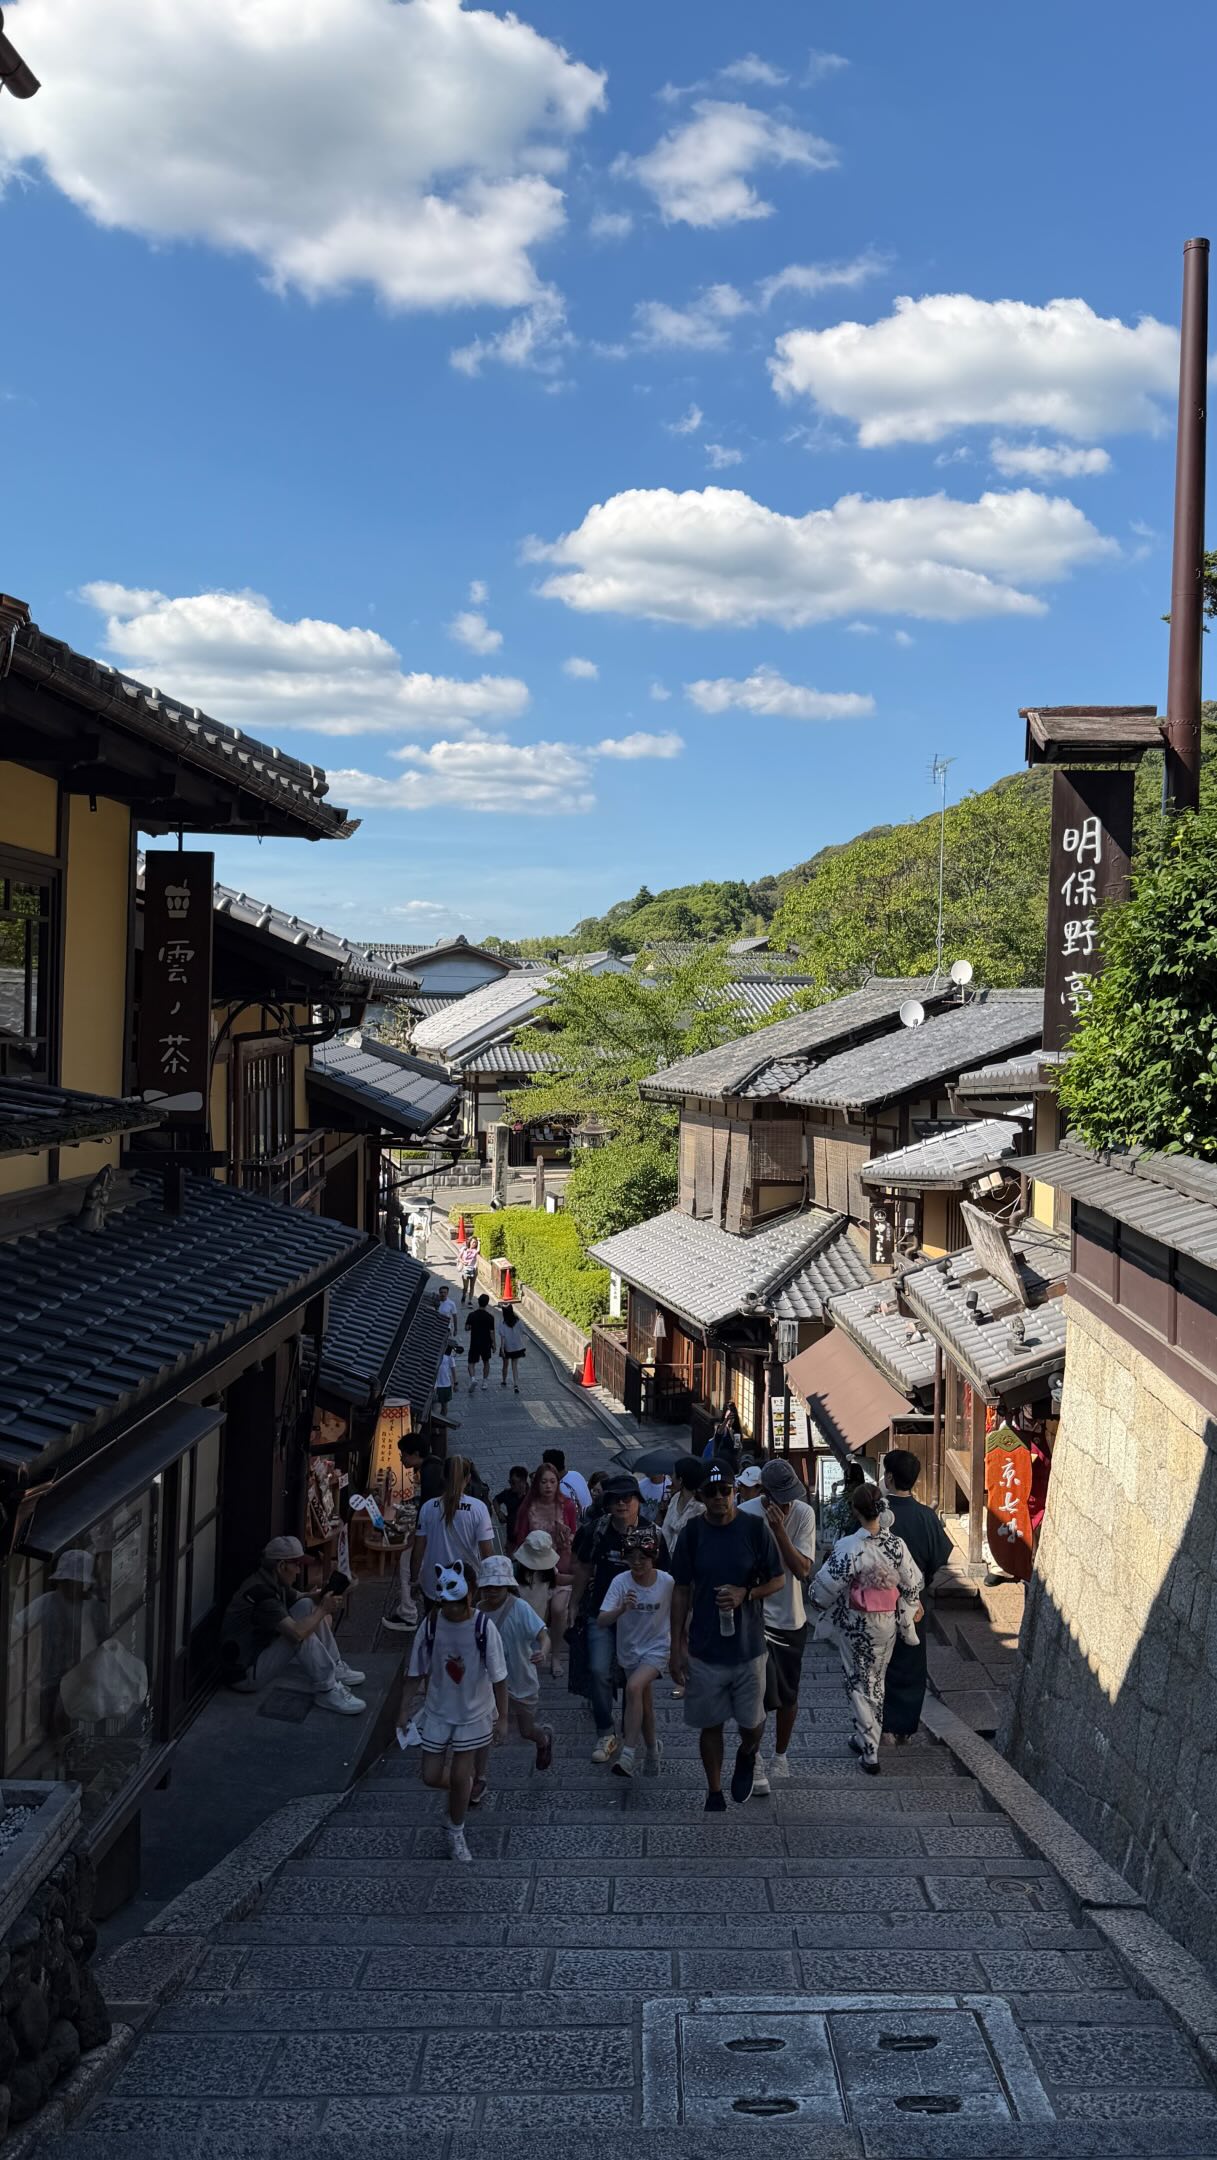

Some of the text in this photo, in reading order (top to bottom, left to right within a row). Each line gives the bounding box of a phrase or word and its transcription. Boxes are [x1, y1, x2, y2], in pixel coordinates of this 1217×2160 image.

[1061, 816, 1101, 1014] 明保野亭
[158, 940, 195, 1073] 雲ノ茶
[998, 1457, 1024, 1543] 京七味
